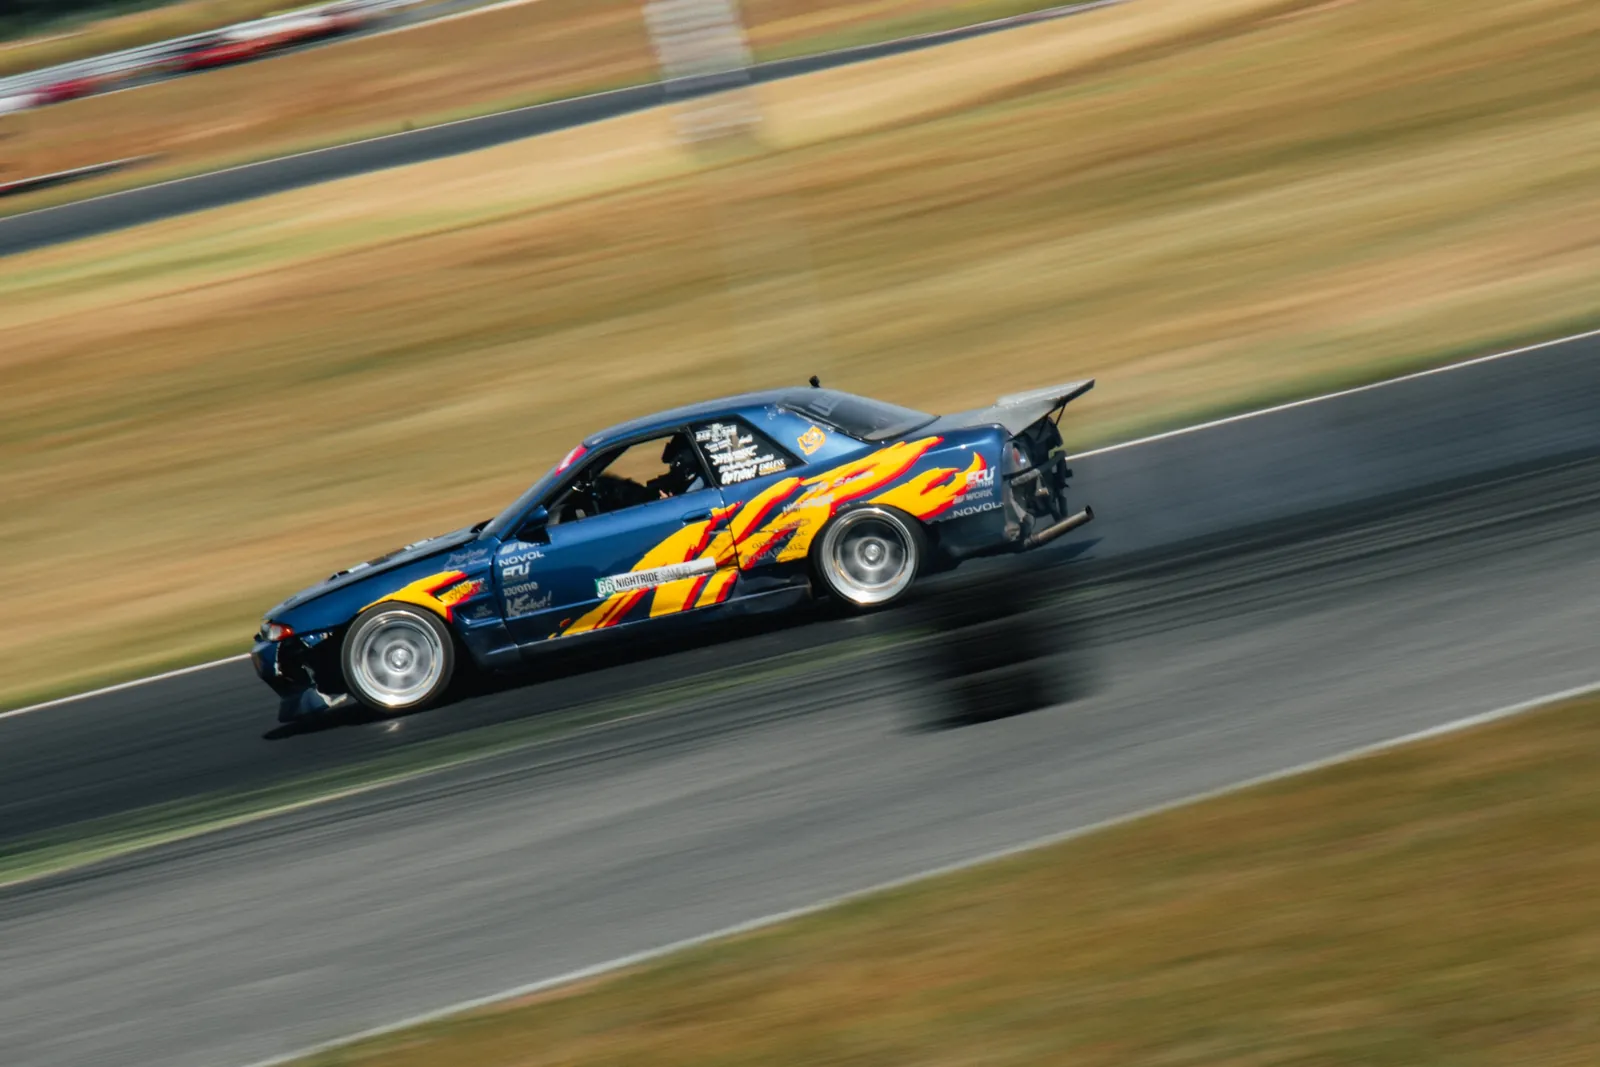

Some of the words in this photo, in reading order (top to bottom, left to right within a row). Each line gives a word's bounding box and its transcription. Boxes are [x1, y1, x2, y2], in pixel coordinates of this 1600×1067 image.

[952, 502, 1003, 518] NOVOL
[499, 551, 545, 567] NOVOL
[597, 578, 614, 594] 66
[615, 571, 659, 589] NIGHTRIDE
